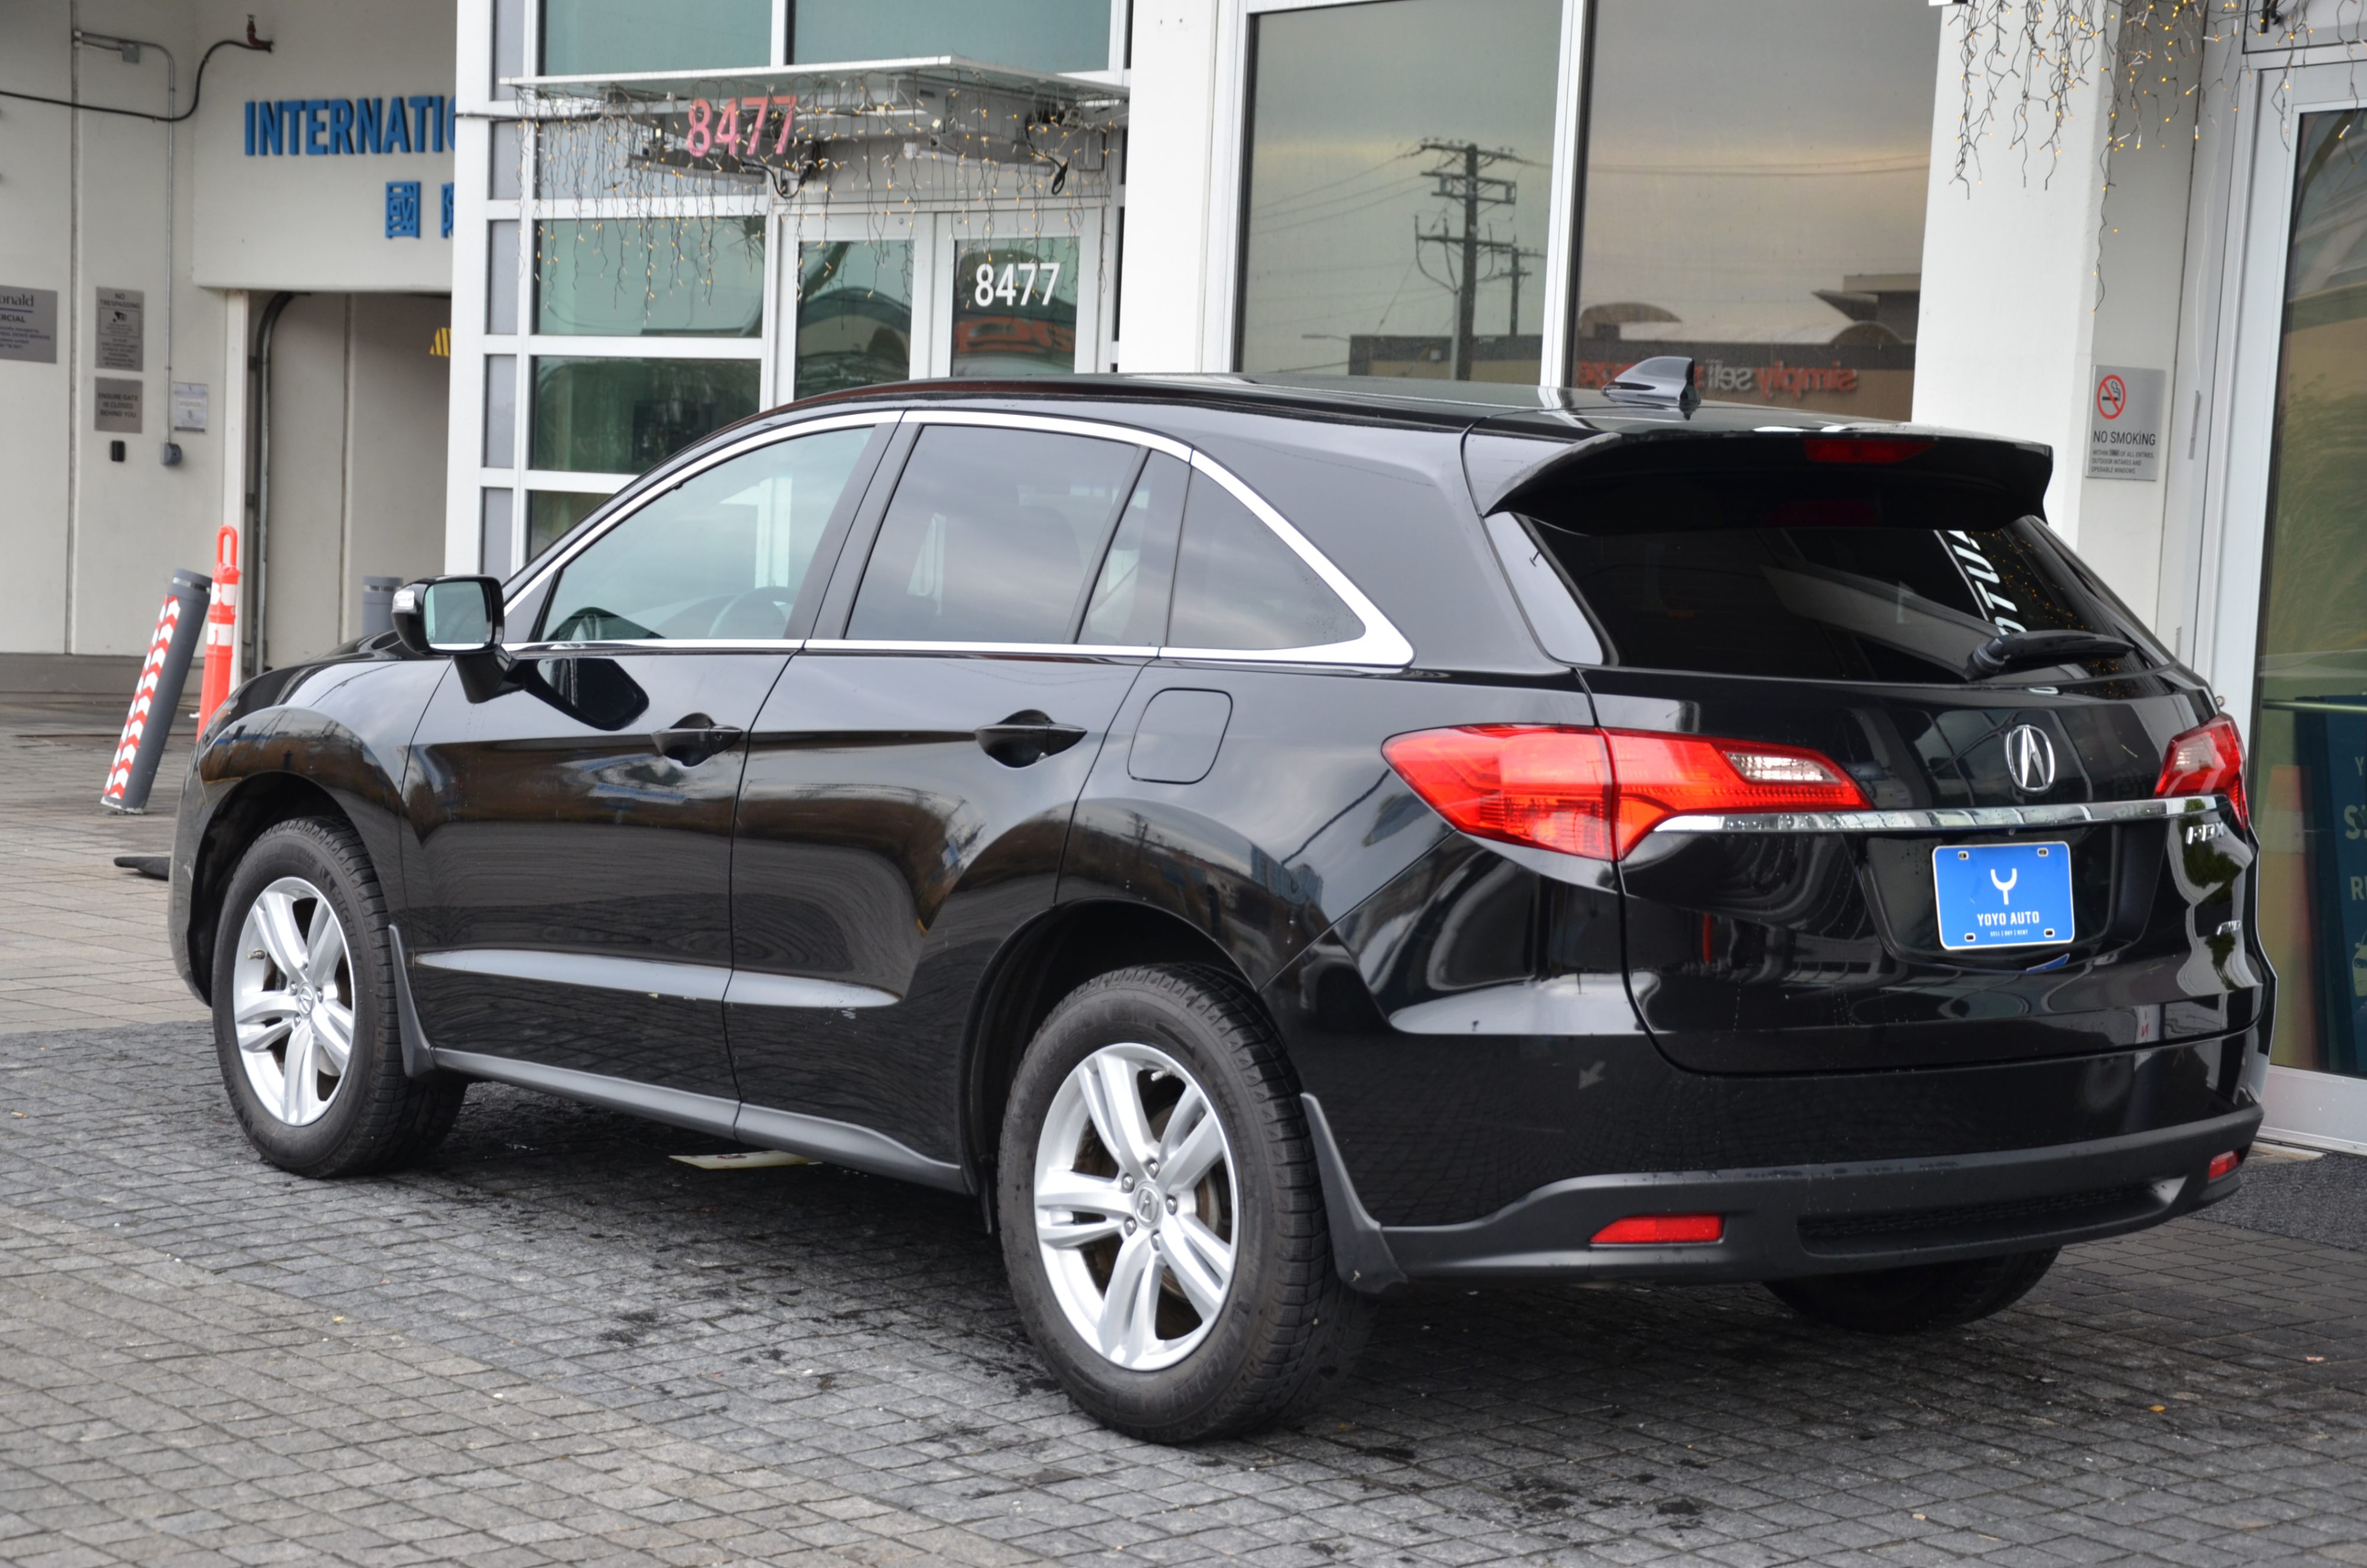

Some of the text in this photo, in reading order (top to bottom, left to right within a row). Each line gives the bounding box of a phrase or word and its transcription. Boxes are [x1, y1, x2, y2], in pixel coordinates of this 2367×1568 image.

[687, 94, 797, 158] 8477
[975, 263, 1060, 306] 8477
[100, 299, 140, 309] TRESPASSING
[0, 314, 25, 323] RCIAL
[98, 392, 122, 401] ENSURE
[100, 409, 122, 417] BEHIND
[2093, 430, 2156, 446] NO SMOKING
[1977, 911, 2040, 927] YOYO AUTO
